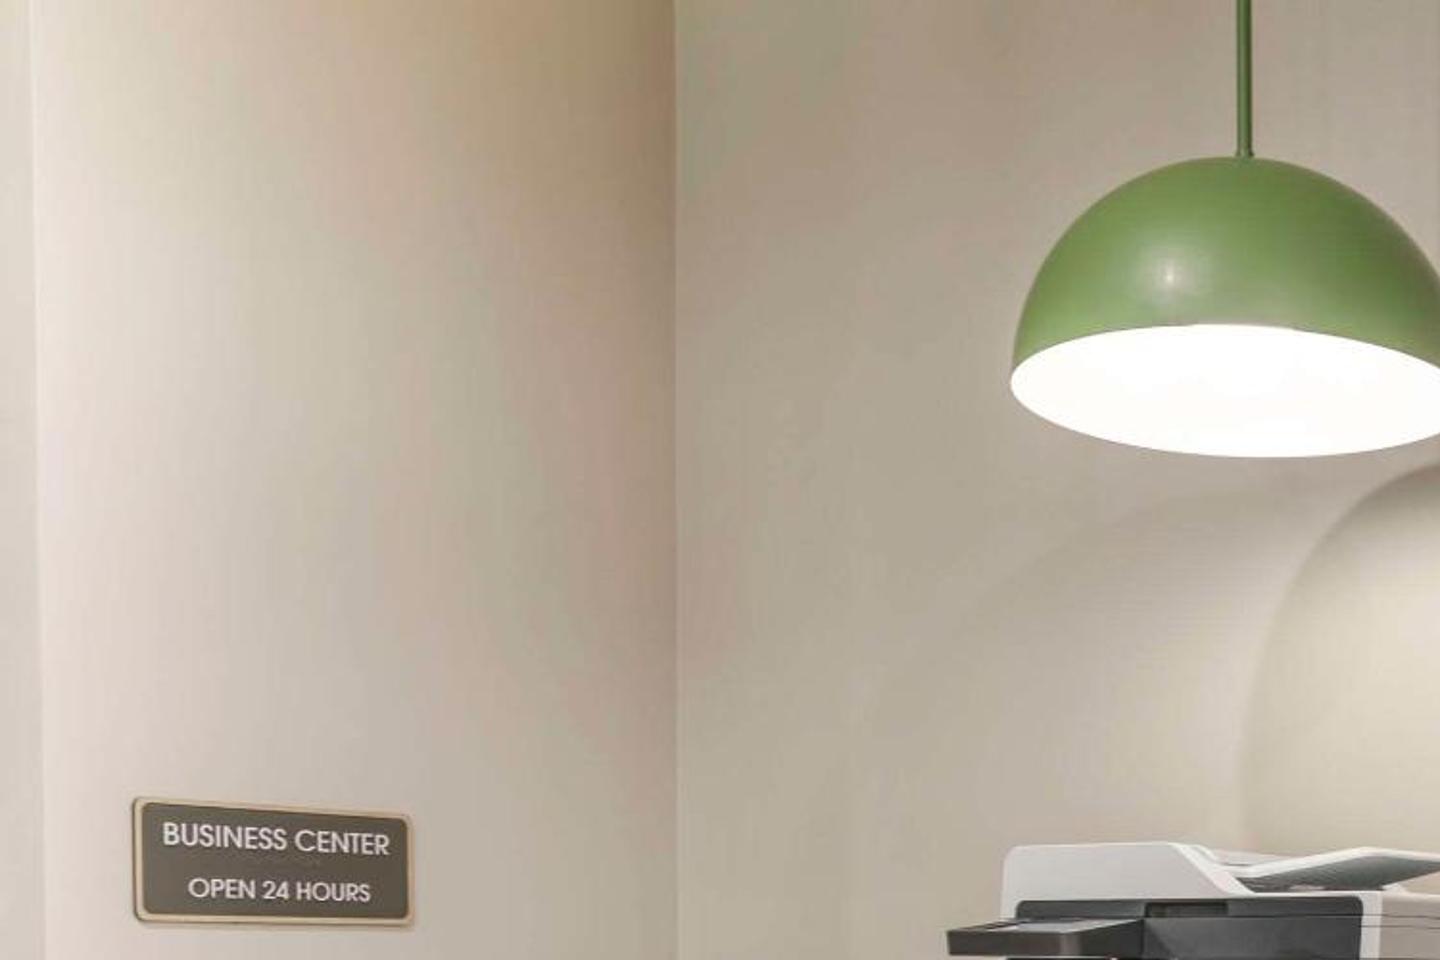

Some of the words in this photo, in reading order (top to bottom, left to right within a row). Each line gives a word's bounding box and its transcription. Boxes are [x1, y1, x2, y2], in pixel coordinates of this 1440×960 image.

[162, 821, 288, 851] BUSINESS
[294, 829, 391, 856] CENTER
[188, 877, 256, 900] OPEN
[262, 880, 289, 900] 24
[295, 881, 371, 903] HOURS
